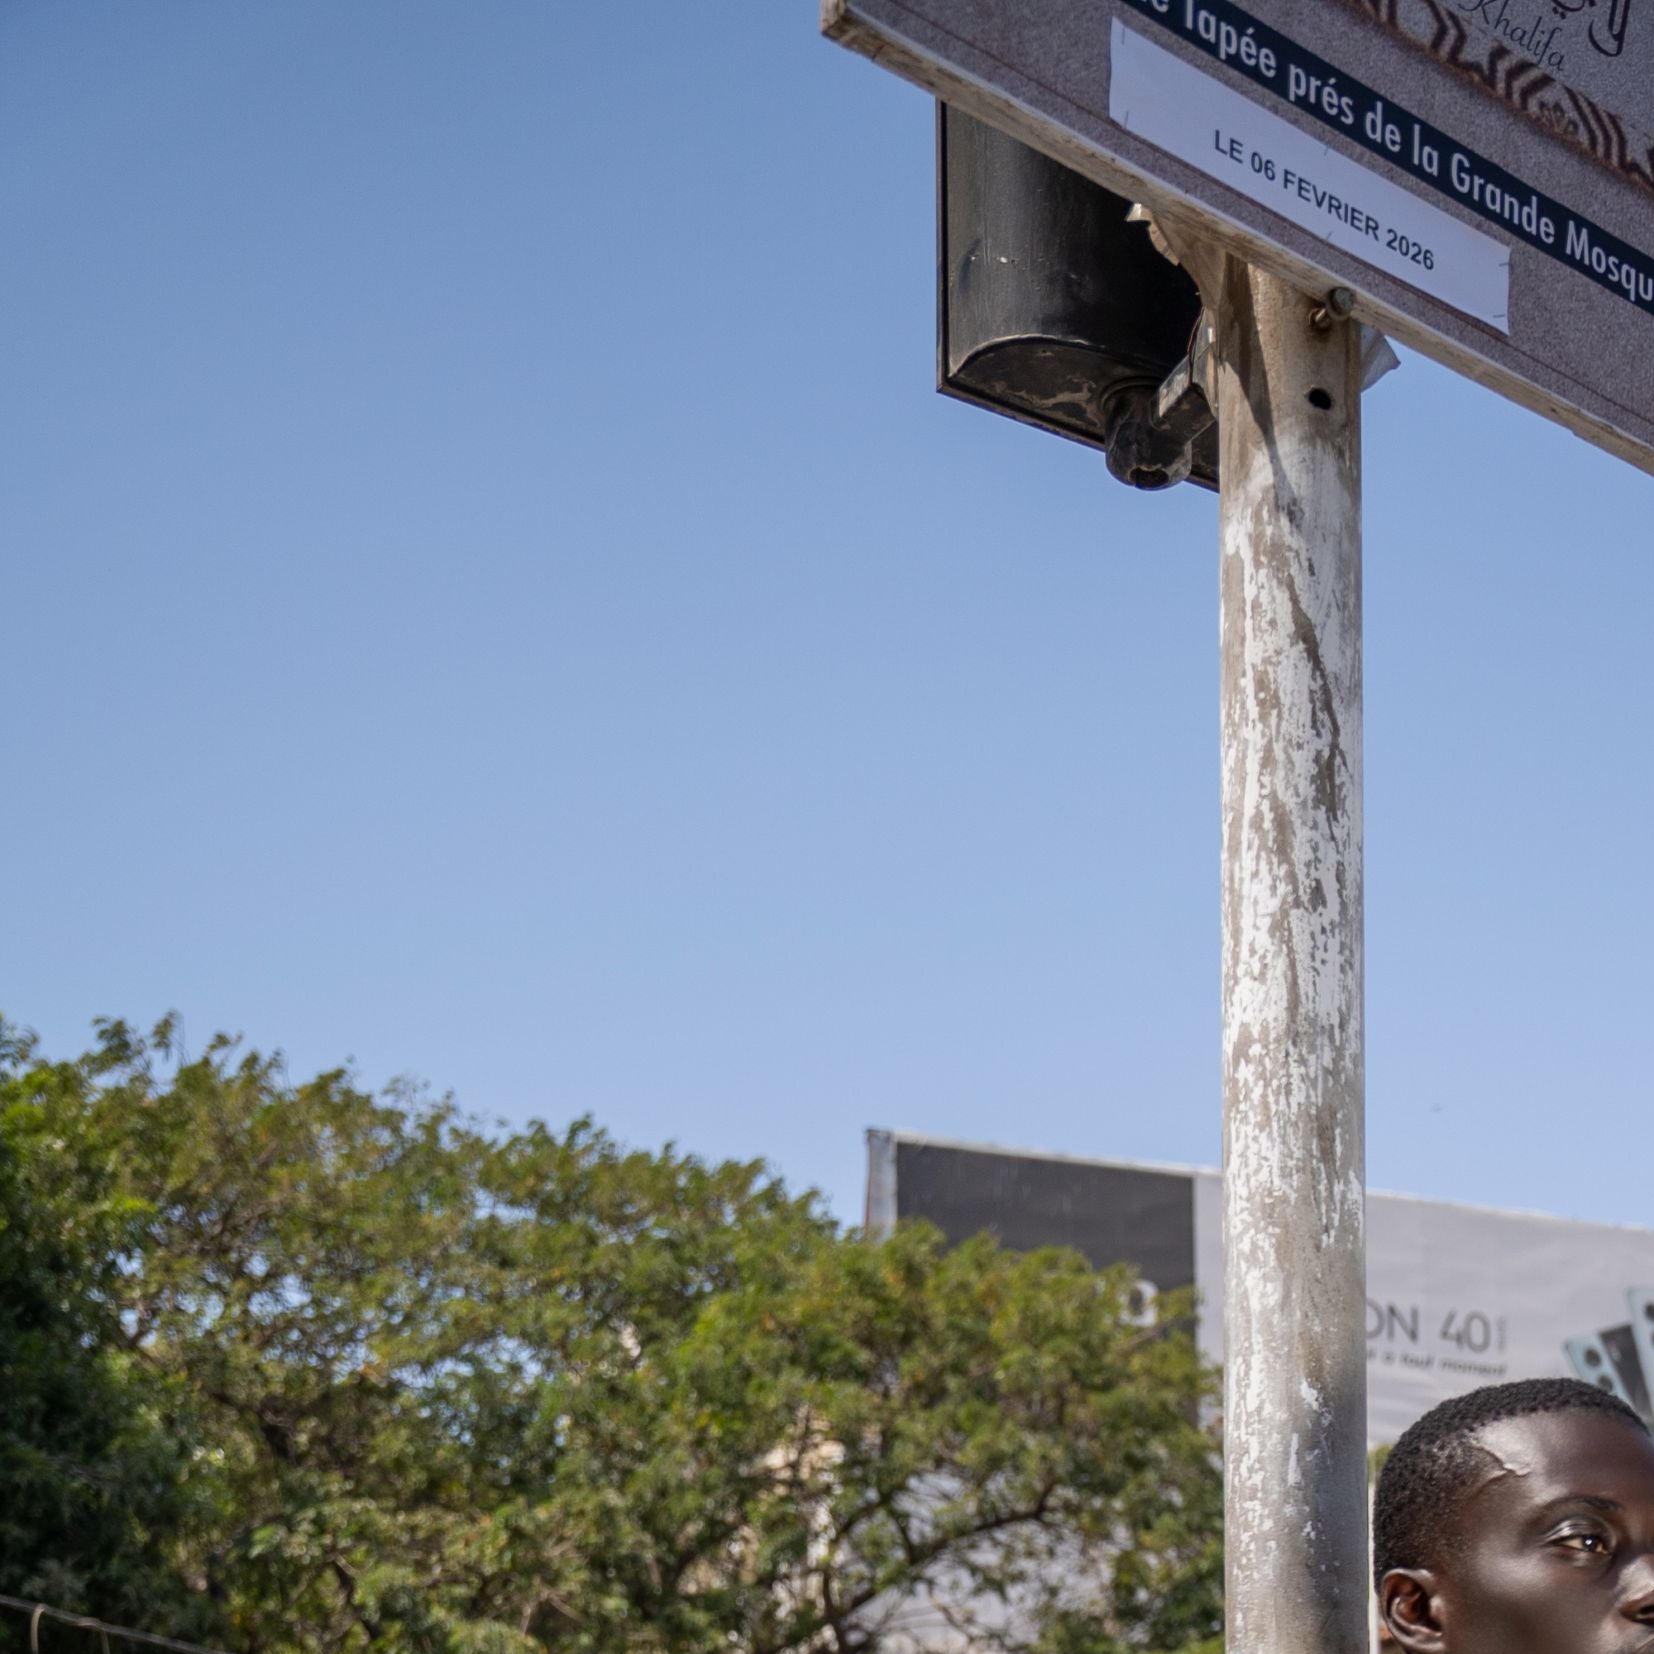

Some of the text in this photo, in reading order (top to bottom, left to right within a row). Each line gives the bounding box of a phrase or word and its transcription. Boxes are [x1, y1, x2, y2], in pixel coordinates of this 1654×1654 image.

[1214, 130, 1435, 271] LE 06 FEVRIER 2026
[1288, 62, 1354, 125] prés
[1365, 101, 1401, 153] de
[1411, 123, 1439, 177] la
[1451, 153, 1555, 245] Grande
[1440, 1306, 1490, 1353] 40
